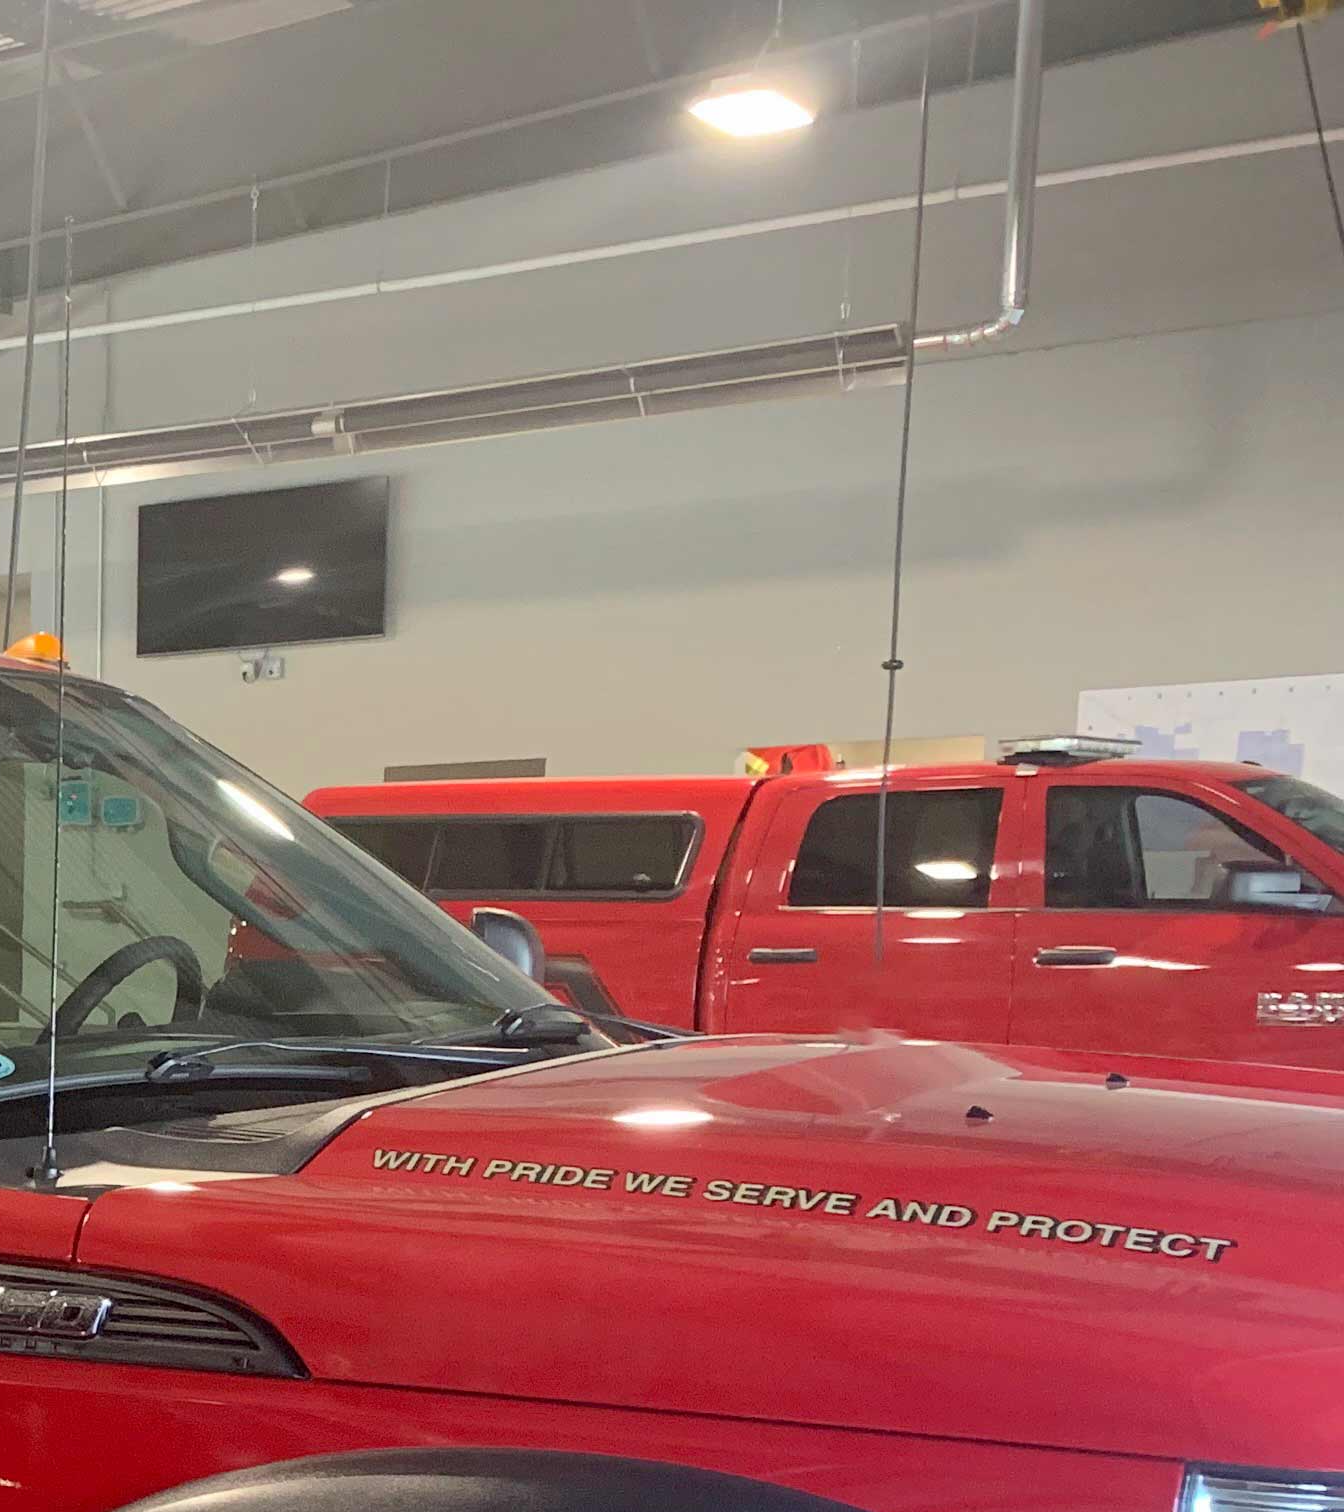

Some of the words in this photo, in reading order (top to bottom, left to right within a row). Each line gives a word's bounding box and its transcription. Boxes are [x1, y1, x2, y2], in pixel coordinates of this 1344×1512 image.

[373, 1149, 478, 1177] WITH
[482, 1158, 617, 1190] PRIDE
[624, 1171, 696, 1198] WE
[702, 1179, 860, 1216] SERVE
[866, 1198, 975, 1229] AND
[986, 1209, 1236, 1263] PROTECT
